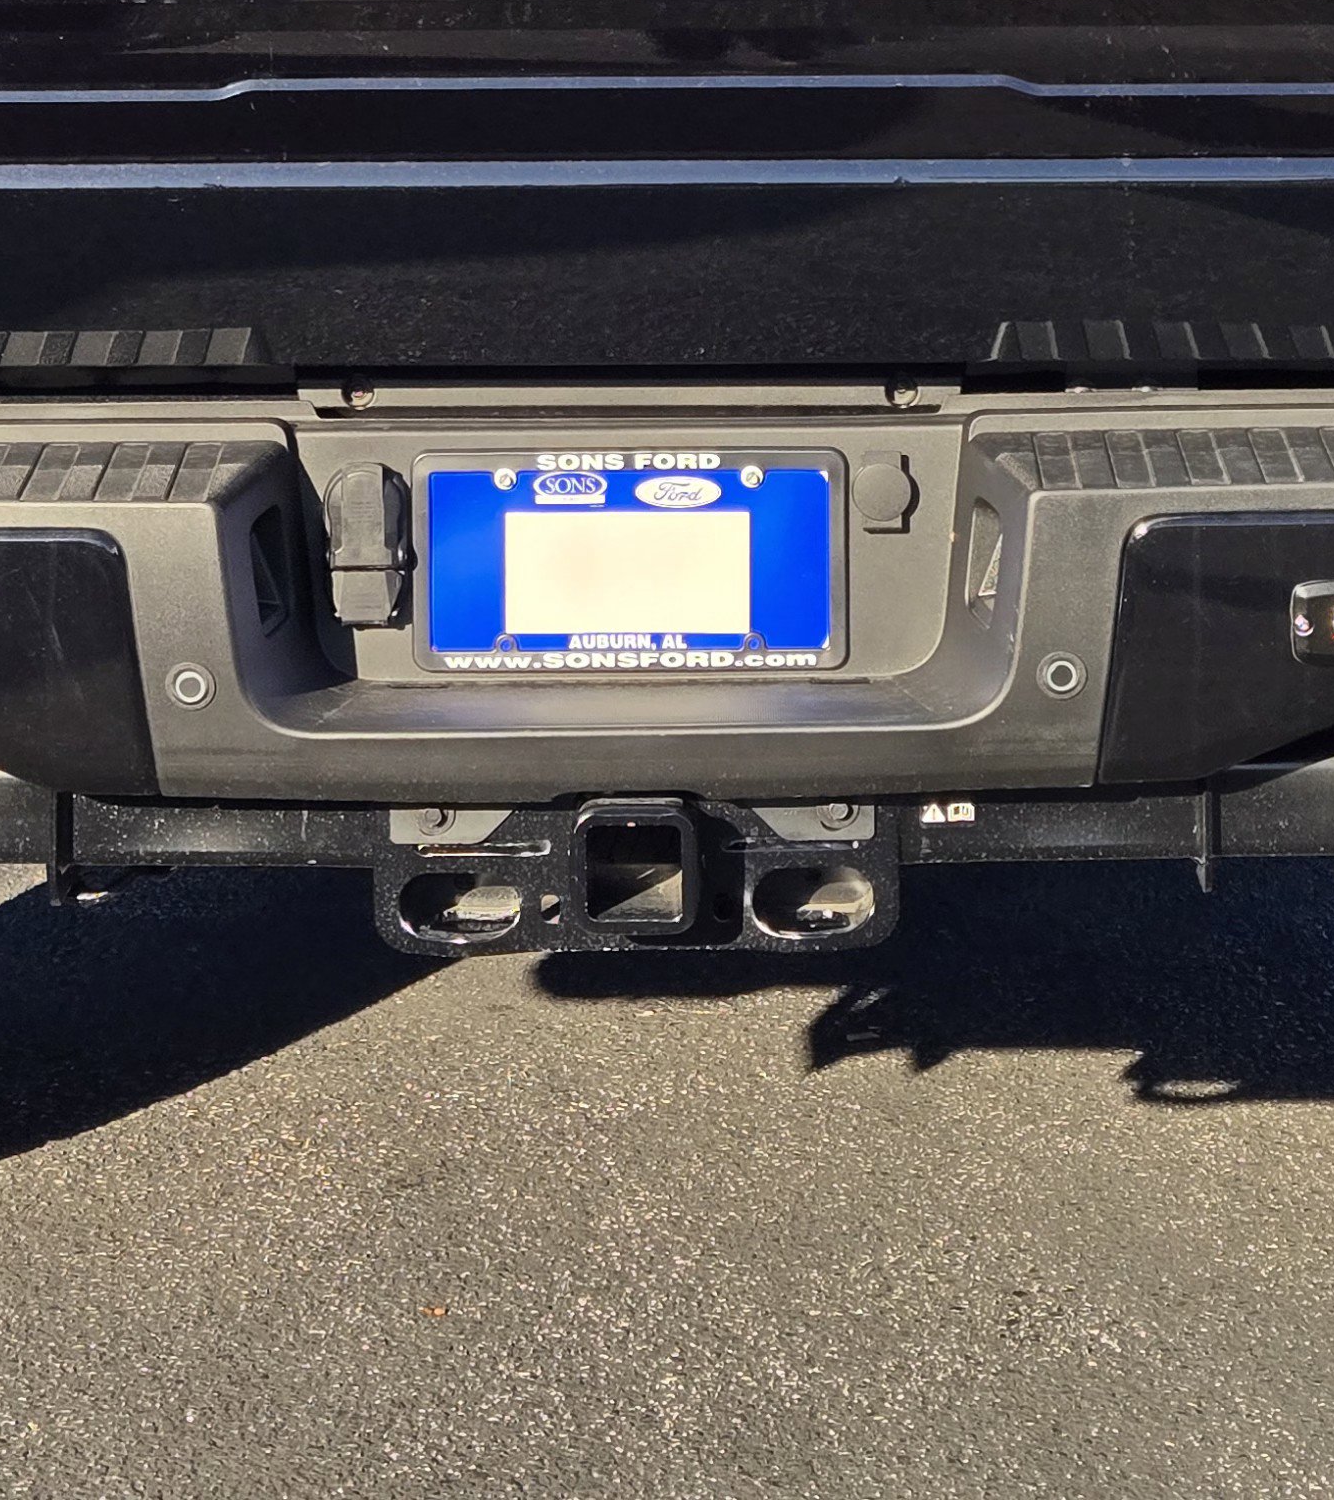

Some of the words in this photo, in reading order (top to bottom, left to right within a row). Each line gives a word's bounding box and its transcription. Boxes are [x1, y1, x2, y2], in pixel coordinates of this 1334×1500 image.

[536, 453, 625, 471] SONS
[634, 453, 722, 470] FORD
[544, 476, 597, 495] SONS
[653, 481, 704, 502] Ford
[568, 634, 657, 651] AUBURN,
[661, 634, 688, 650] AL
[444, 652, 818, 669] www.SONSFORD.com
